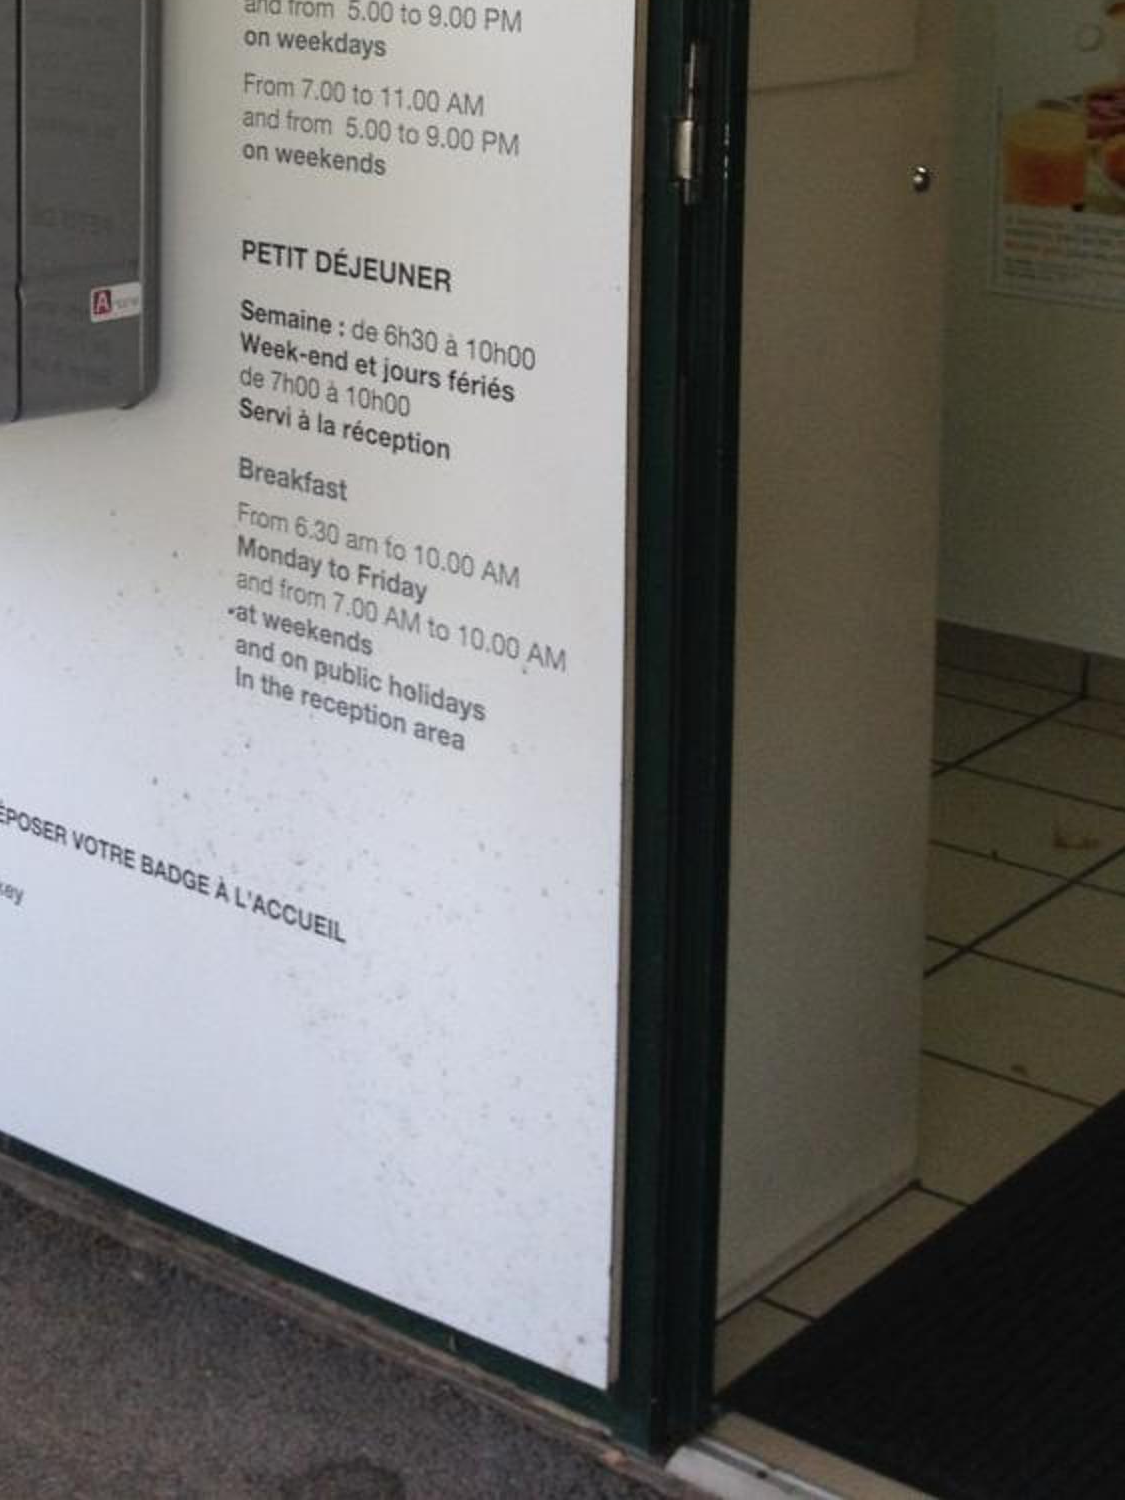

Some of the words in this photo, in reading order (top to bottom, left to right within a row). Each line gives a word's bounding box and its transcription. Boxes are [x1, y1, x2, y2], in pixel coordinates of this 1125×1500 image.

[244, 29, 270, 49] on
[277, 30, 387, 60] weekdays
[348, 0, 394, 23] 5.00
[400, 4, 422, 26] to
[428, 4, 476, 29] 9.00
[484, 8, 523, 33] PM
[244, 72, 294, 98] From
[301, 79, 346, 103] 7.00
[352, 83, 373, 106] to
[380, 87, 440, 113] 11.00
[446, 92, 484, 117] AM
[242, 108, 280, 130] and
[286, 110, 333, 135] from
[346, 116, 391, 142] 5.00
[397, 121, 419, 145] to
[426, 125, 474, 151] 9.00
[482, 131, 520, 157] PM
[242, 142, 268, 161] on
[275, 146, 387, 177] weekends
[241, 239, 308, 271] PETIT
[316, 248, 452, 293] DÉJEUNER
[240, 299, 332, 335] Semaine
[352, 320, 378, 343] de
[384, 324, 438, 354] 6h30
[446, 334, 458, 357] à
[467, 339, 536, 372] 10h00
[240, 331, 348, 372] Week-end
[355, 354, 377, 378] et
[383, 360, 441, 389] jours
[449, 370, 515, 404] fériés
[240, 366, 264, 389] de
[271, 371, 320, 400] 7h00
[326, 381, 338, 404] à
[347, 386, 410, 418] 10h00
[239, 397, 291, 428] Servi
[299, 409, 310, 432] à
[318, 413, 335, 437] la
[343, 420, 451, 461] réception
[239, 456, 348, 502] Breakfast
[238, 501, 289, 534] From
[295, 515, 339, 546] 6.30
[346, 532, 378, 556] am
[385, 534, 405, 561] to
[414, 544, 474, 578] 10.00
[481, 560, 520, 590] AM
[238, 535, 322, 580] Monday
[329, 557, 350, 582] to
[358, 564, 427, 605] Friday
[236, 570, 273, 597] and
[280, 578, 326, 611] from
[333, 592, 378, 625] 7.00
[385, 606, 421, 635] AM
[427, 616, 450, 642] to
[458, 624, 521, 661] 10.00
[526, 642, 567, 673] AM
[236, 602, 257, 624] at
[262, 610, 373, 657] weekends
[236, 637, 274, 663] and
[281, 648, 308, 673] on
[314, 658, 382, 694] public
[389, 674, 486, 722] holidays
[261, 673, 294, 703] the
[301, 689, 406, 735] reception
[413, 719, 465, 752] area
[73, 829, 136, 870] VOTRE
[141, 853, 210, 896] BADGE
[215, 876, 230, 903] À
[235, 885, 347, 943] L'ACCUEIL
